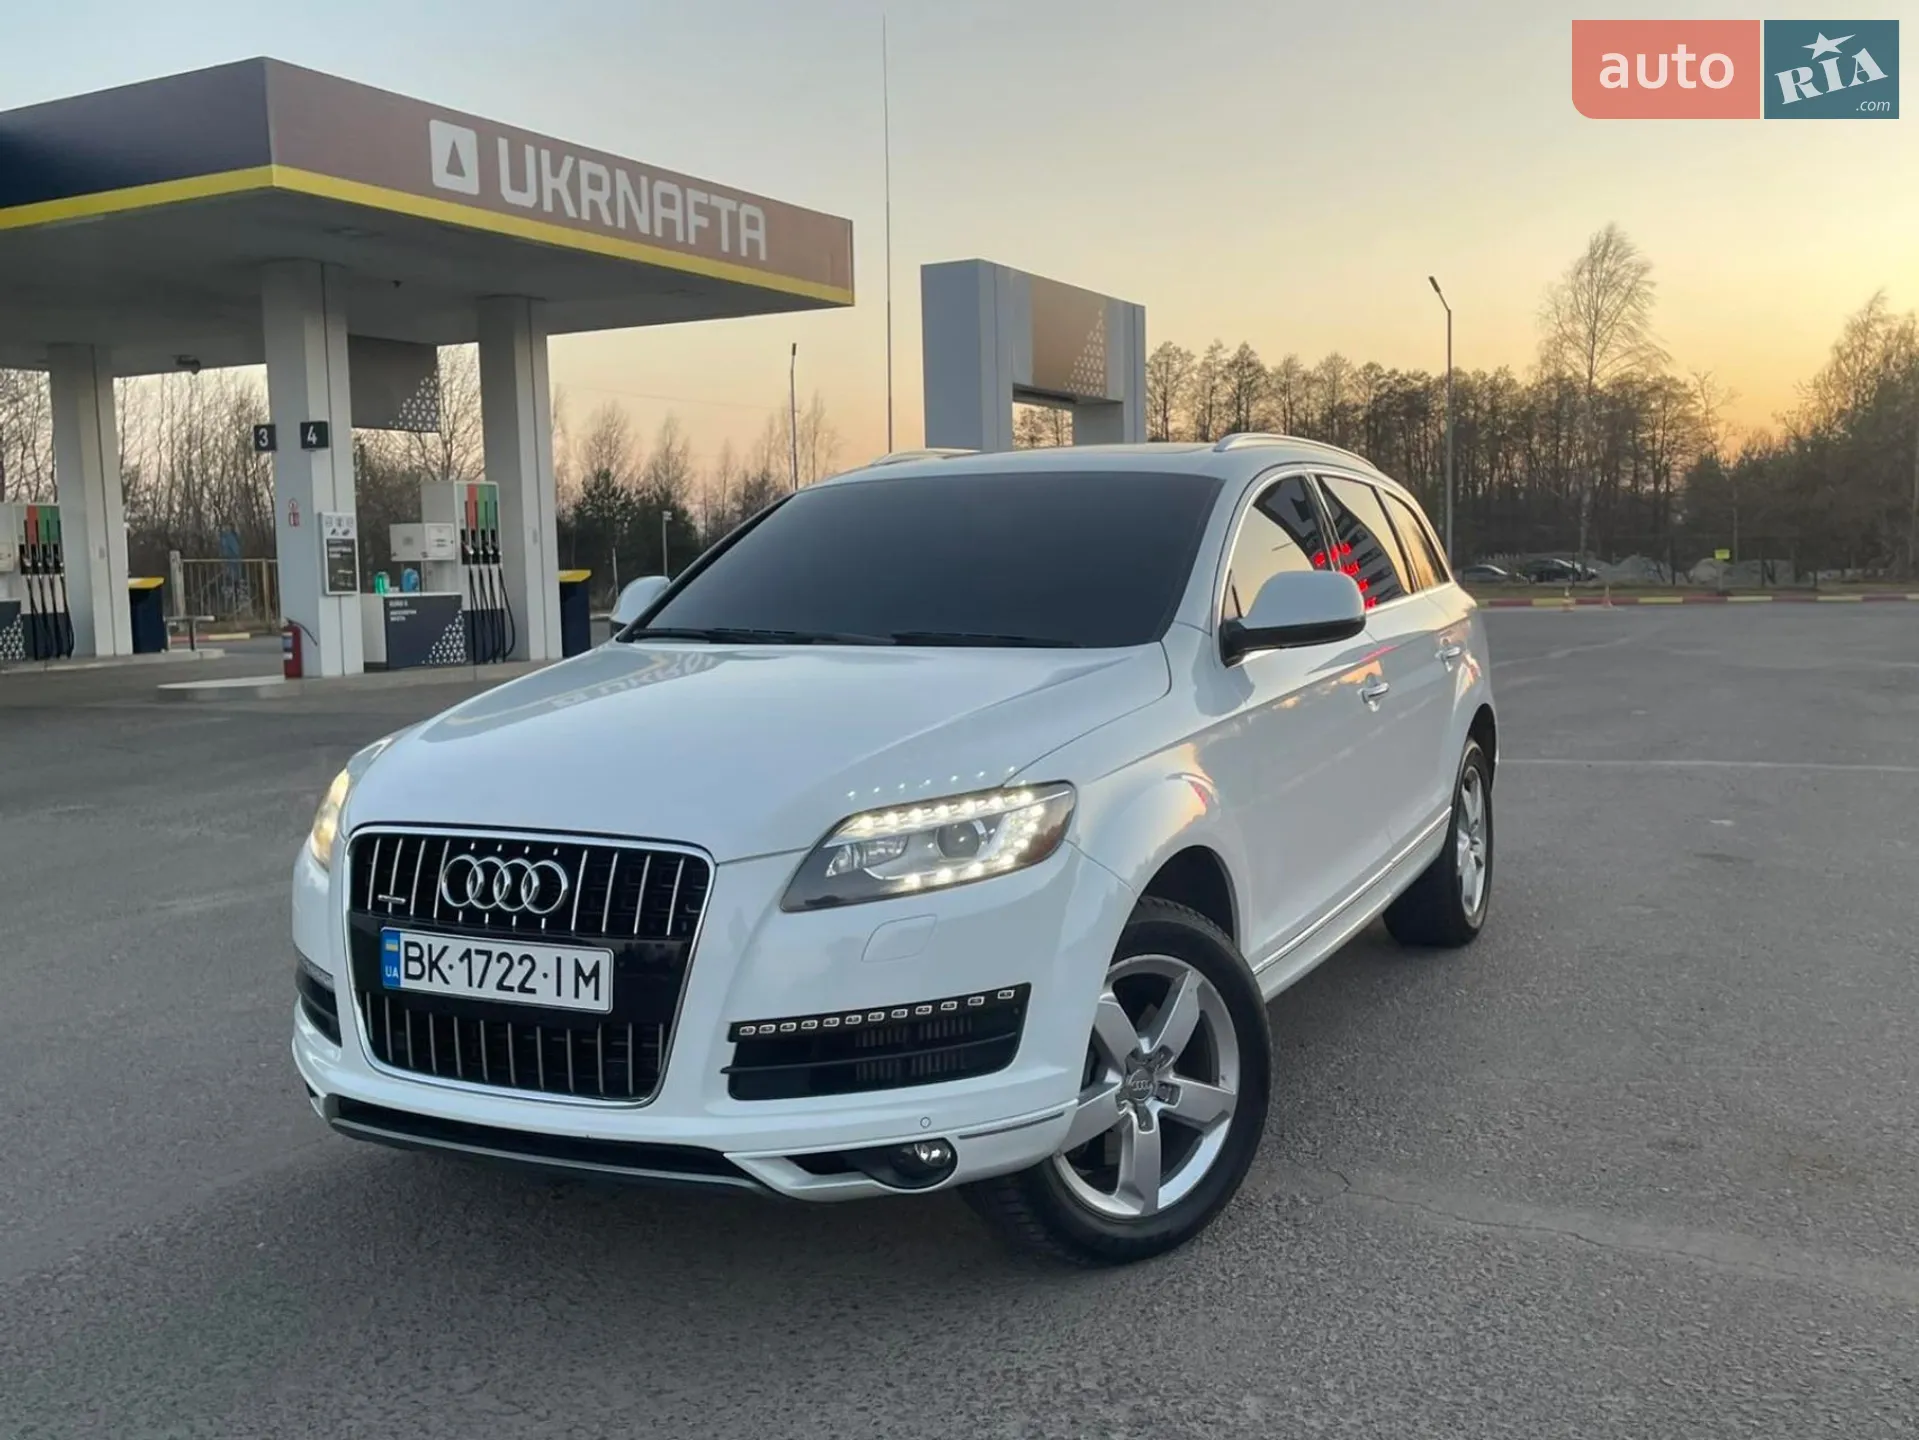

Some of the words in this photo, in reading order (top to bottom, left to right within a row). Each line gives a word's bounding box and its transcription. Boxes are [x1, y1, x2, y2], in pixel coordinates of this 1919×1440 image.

[498, 137, 766, 260] UKRNAFTA
[258, 428, 268, 447] 3
[307, 425, 317, 445] 4
[385, 966, 399, 979] UA
